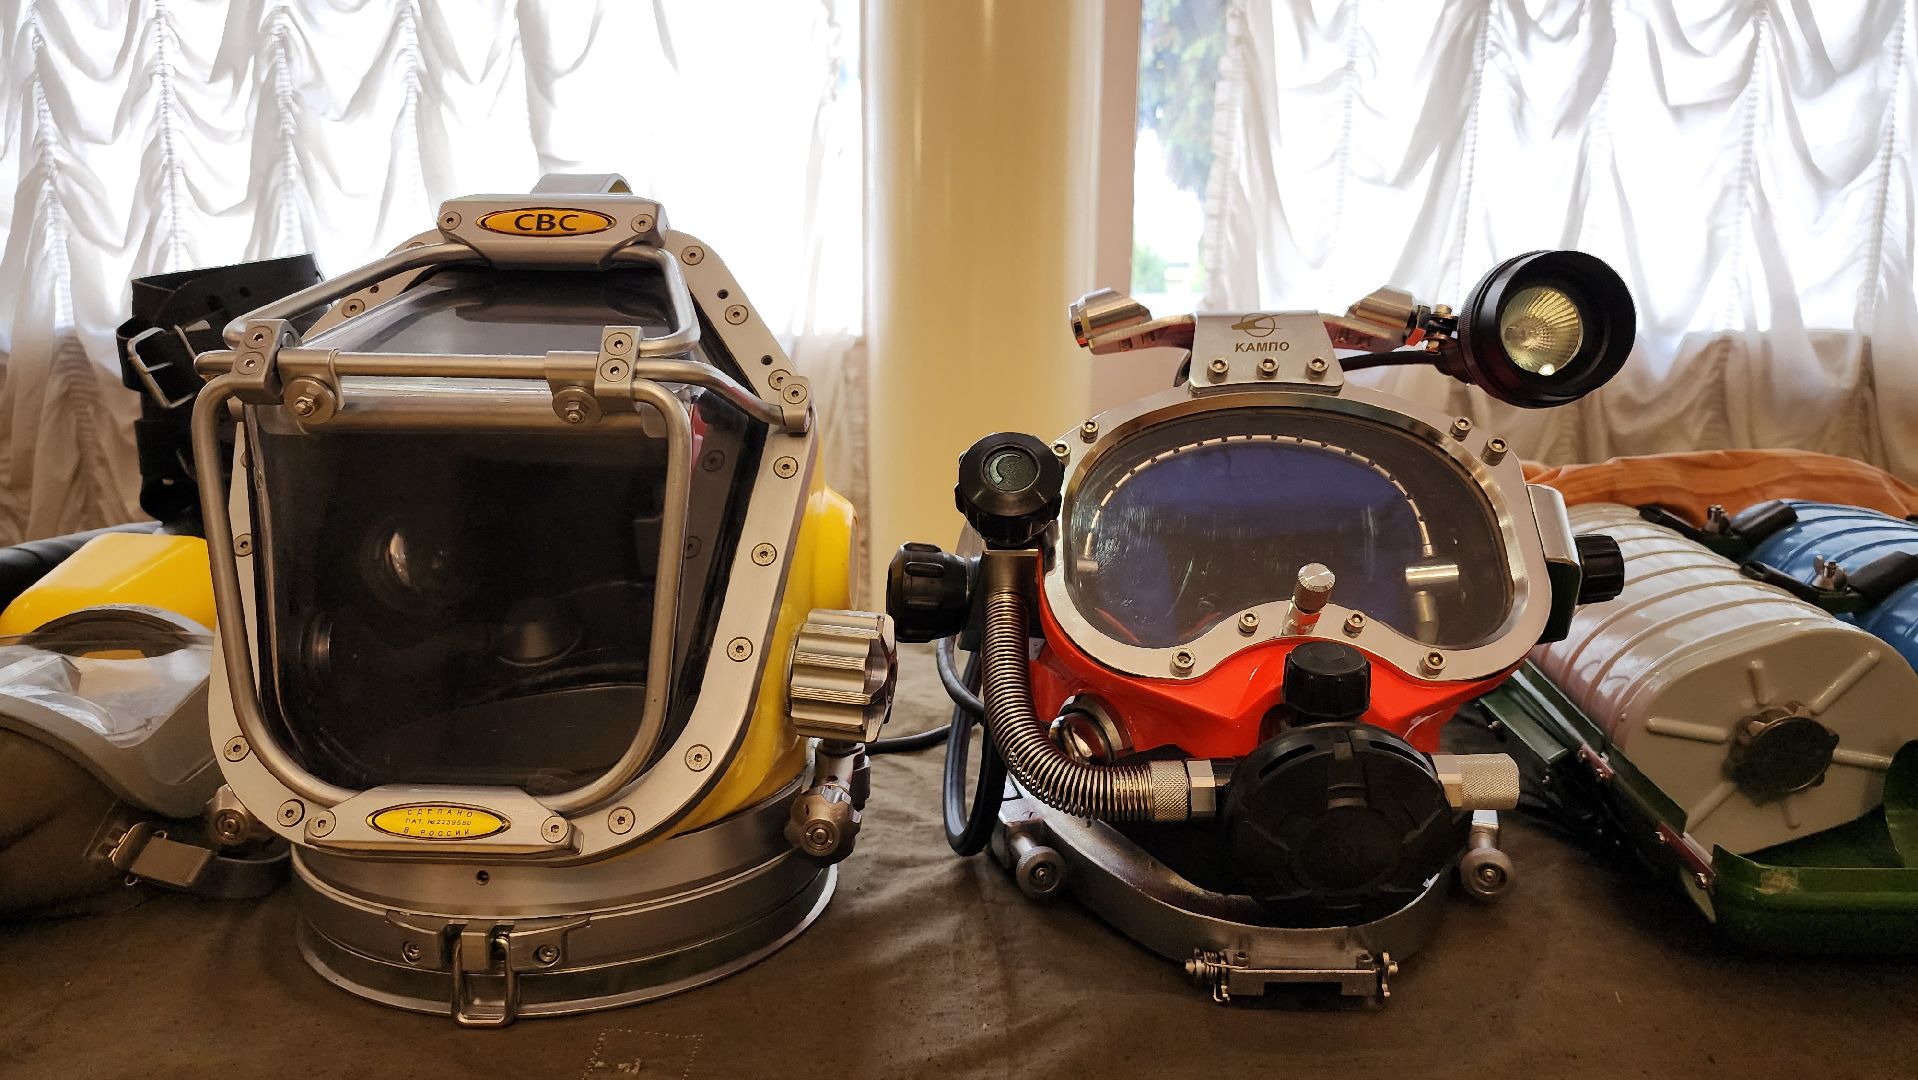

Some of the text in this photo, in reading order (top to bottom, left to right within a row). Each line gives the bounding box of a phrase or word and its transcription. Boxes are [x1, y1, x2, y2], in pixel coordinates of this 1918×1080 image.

[1235, 341, 1290, 353] КАМПО
[407, 808, 473, 818] СДЕЛАНО
[403, 826, 470, 837] В РОССИИ
